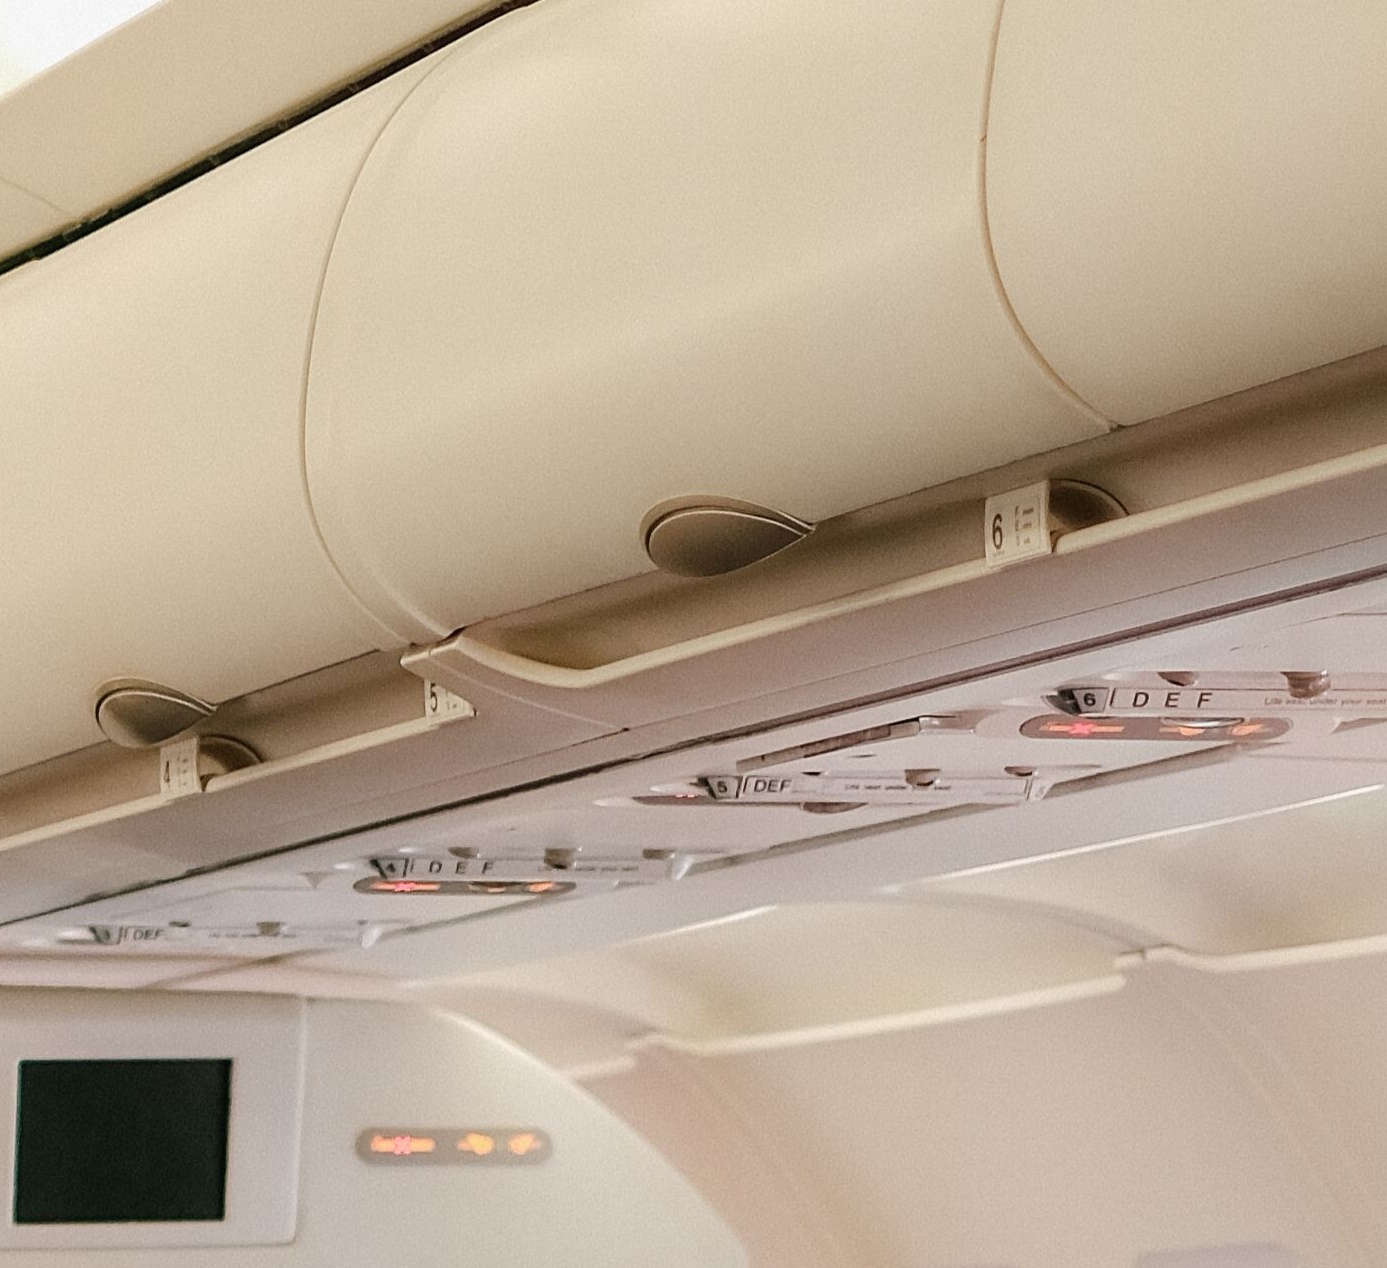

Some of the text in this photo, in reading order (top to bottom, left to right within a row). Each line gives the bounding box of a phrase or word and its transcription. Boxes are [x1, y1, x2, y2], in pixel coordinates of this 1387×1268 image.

[992, 513, 1003, 550] 6
[1083, 692, 1097, 707] 6
[1132, 691, 1213, 708] D E F
[717, 781, 728, 793] 5
[753, 779, 793, 793] DEF
[429, 860, 494, 875] D E F
